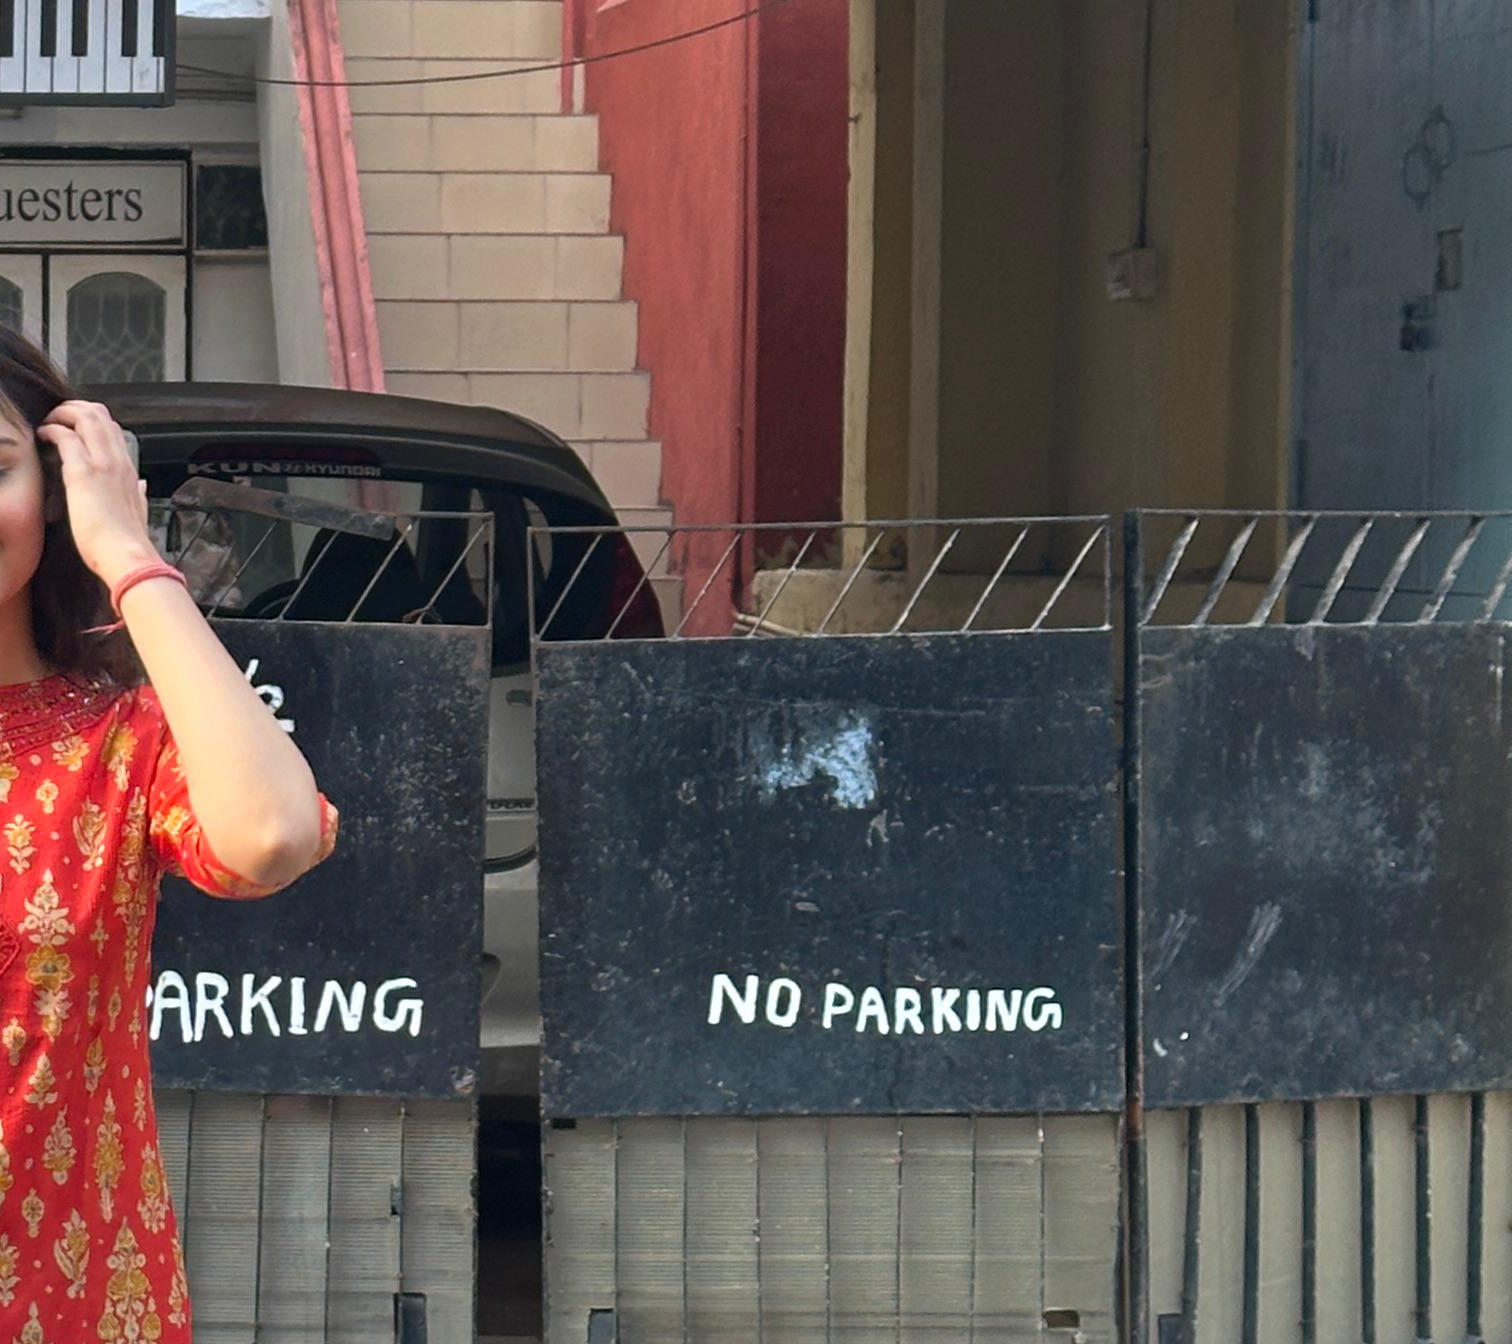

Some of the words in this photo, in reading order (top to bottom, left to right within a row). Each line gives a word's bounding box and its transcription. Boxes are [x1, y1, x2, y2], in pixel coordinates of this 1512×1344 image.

[145, 970, 424, 1043] ARKING
[708, 973, 802, 1028] NO
[822, 982, 1063, 1035] PARKING
